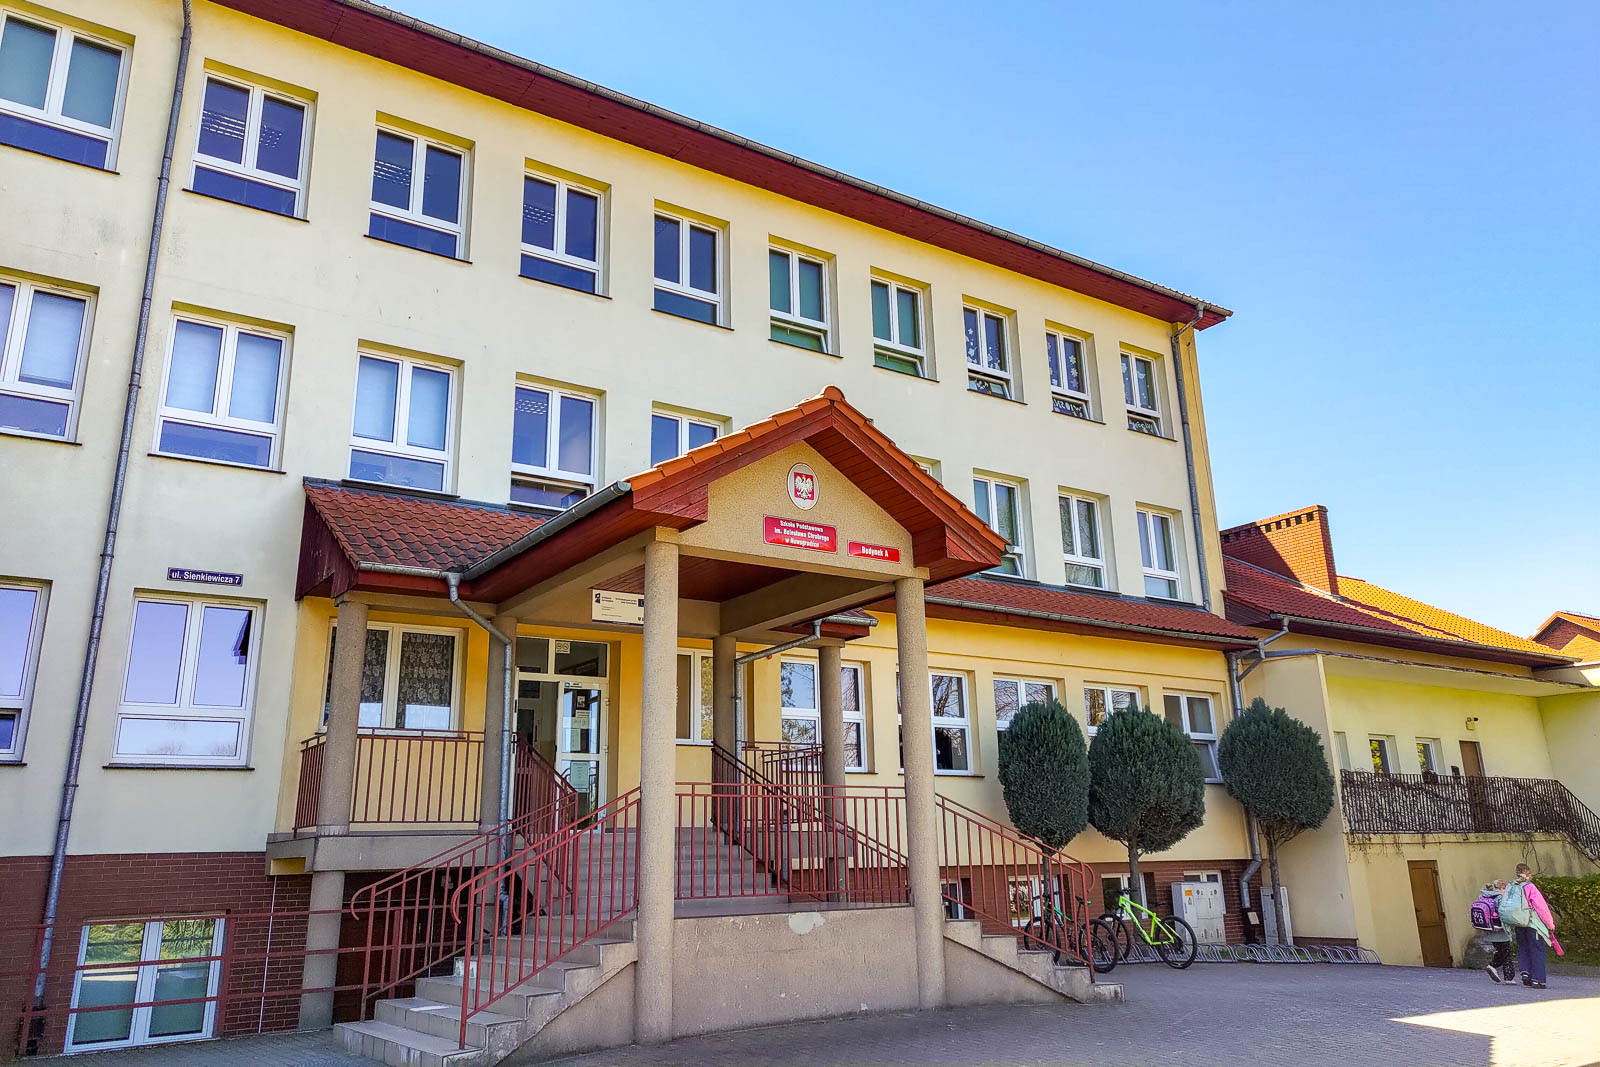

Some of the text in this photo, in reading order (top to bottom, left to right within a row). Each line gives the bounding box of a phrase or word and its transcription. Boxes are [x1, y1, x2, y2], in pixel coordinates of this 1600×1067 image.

[807, 532, 829, 542] Chrobrego
[862, 545, 889, 557] Budynek A
[183, 571, 233, 583] Sienkiewicza
[235, 576, 240, 584] 7
